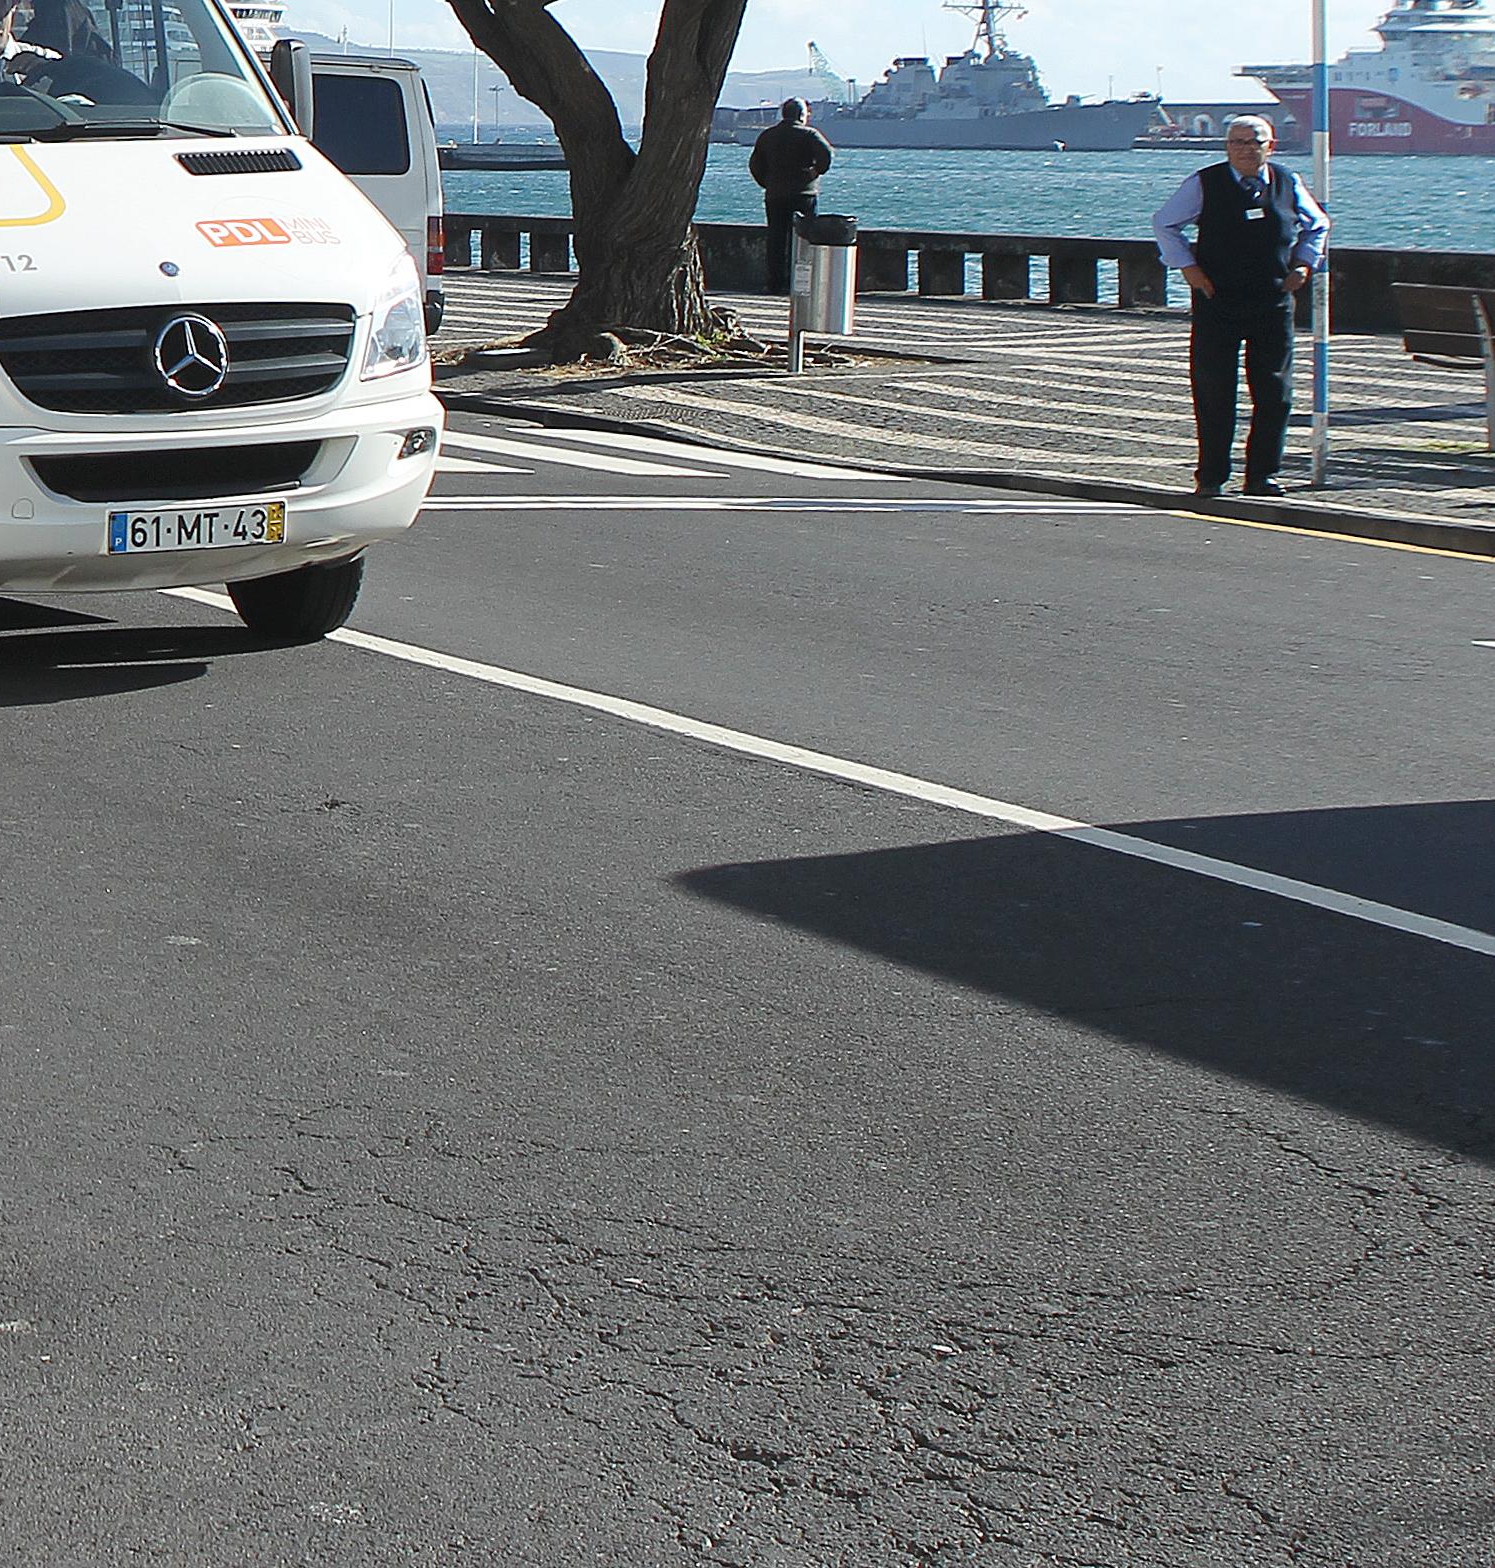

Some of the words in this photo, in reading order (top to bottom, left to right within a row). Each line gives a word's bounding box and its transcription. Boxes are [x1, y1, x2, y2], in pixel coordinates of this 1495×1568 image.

[278, 217, 331, 230] MINI
[198, 221, 289, 244] PDL
[291, 230, 341, 245] BUS
[0, 255, 37, 272] 12
[115, 538, 123, 547] P
